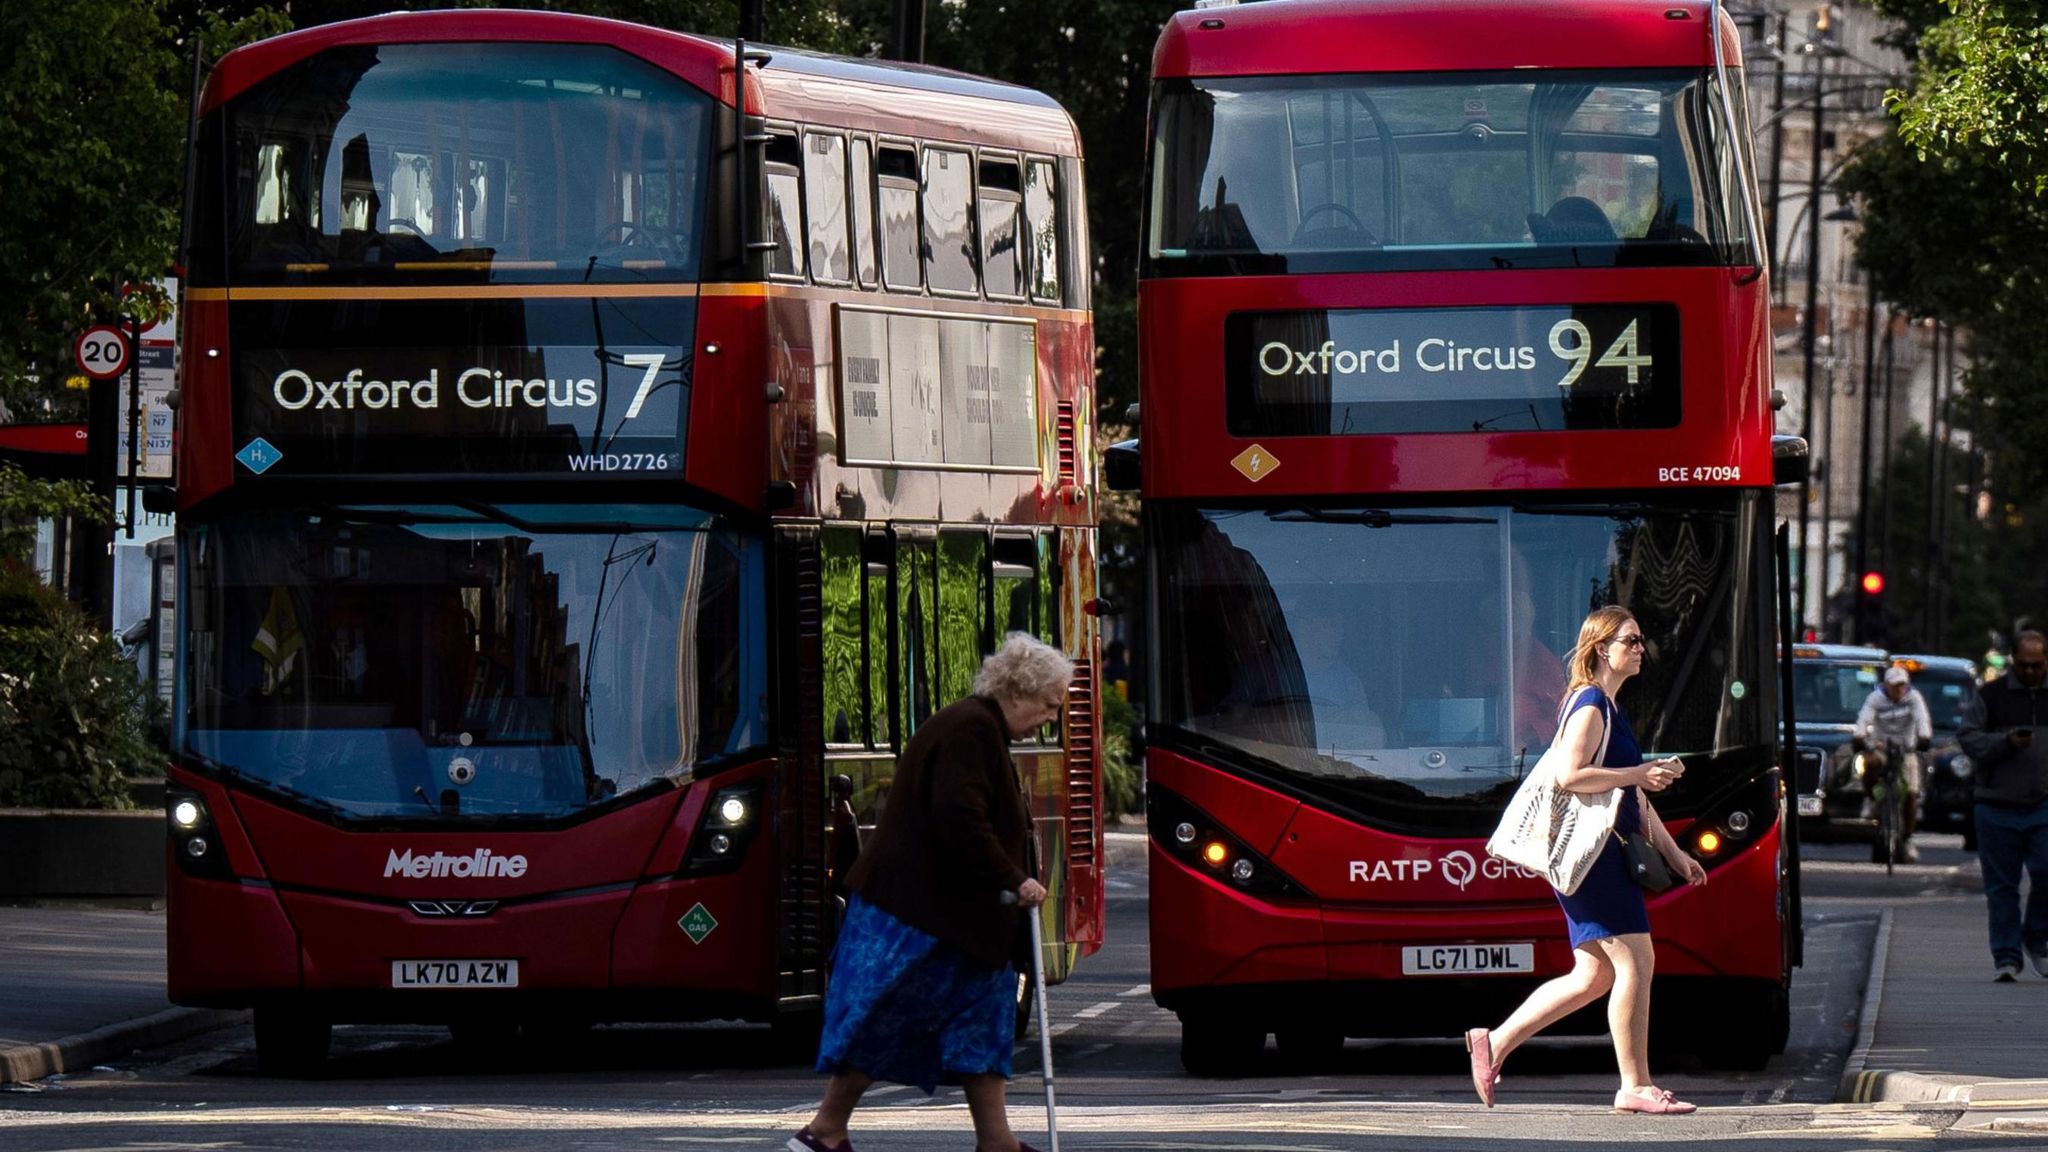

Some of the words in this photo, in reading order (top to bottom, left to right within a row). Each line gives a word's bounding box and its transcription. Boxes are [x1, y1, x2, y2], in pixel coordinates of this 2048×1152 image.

[85, 341, 121, 363] 20
[1259, 339, 1400, 375] Oxford
[1415, 338, 1536, 373] Circus
[1548, 318, 1653, 386] 94
[273, 368, 438, 410] Oxford
[456, 367, 598, 408] Circus
[623, 354, 667, 419] 7
[153, 418, 167, 426] N7
[147, 440, 171, 448] N137
[568, 454, 668, 471] WHD2726
[1659, 467, 1688, 482] BCE
[1693, 466, 1741, 481] 47094
[383, 848, 528, 878] Metroline
[1349, 860, 1432, 882] RATP
[1417, 947, 1468, 970] LG71
[1475, 946, 1520, 970] DWL
[402, 963, 459, 984] LK70
[467, 963, 509, 984] AZW
